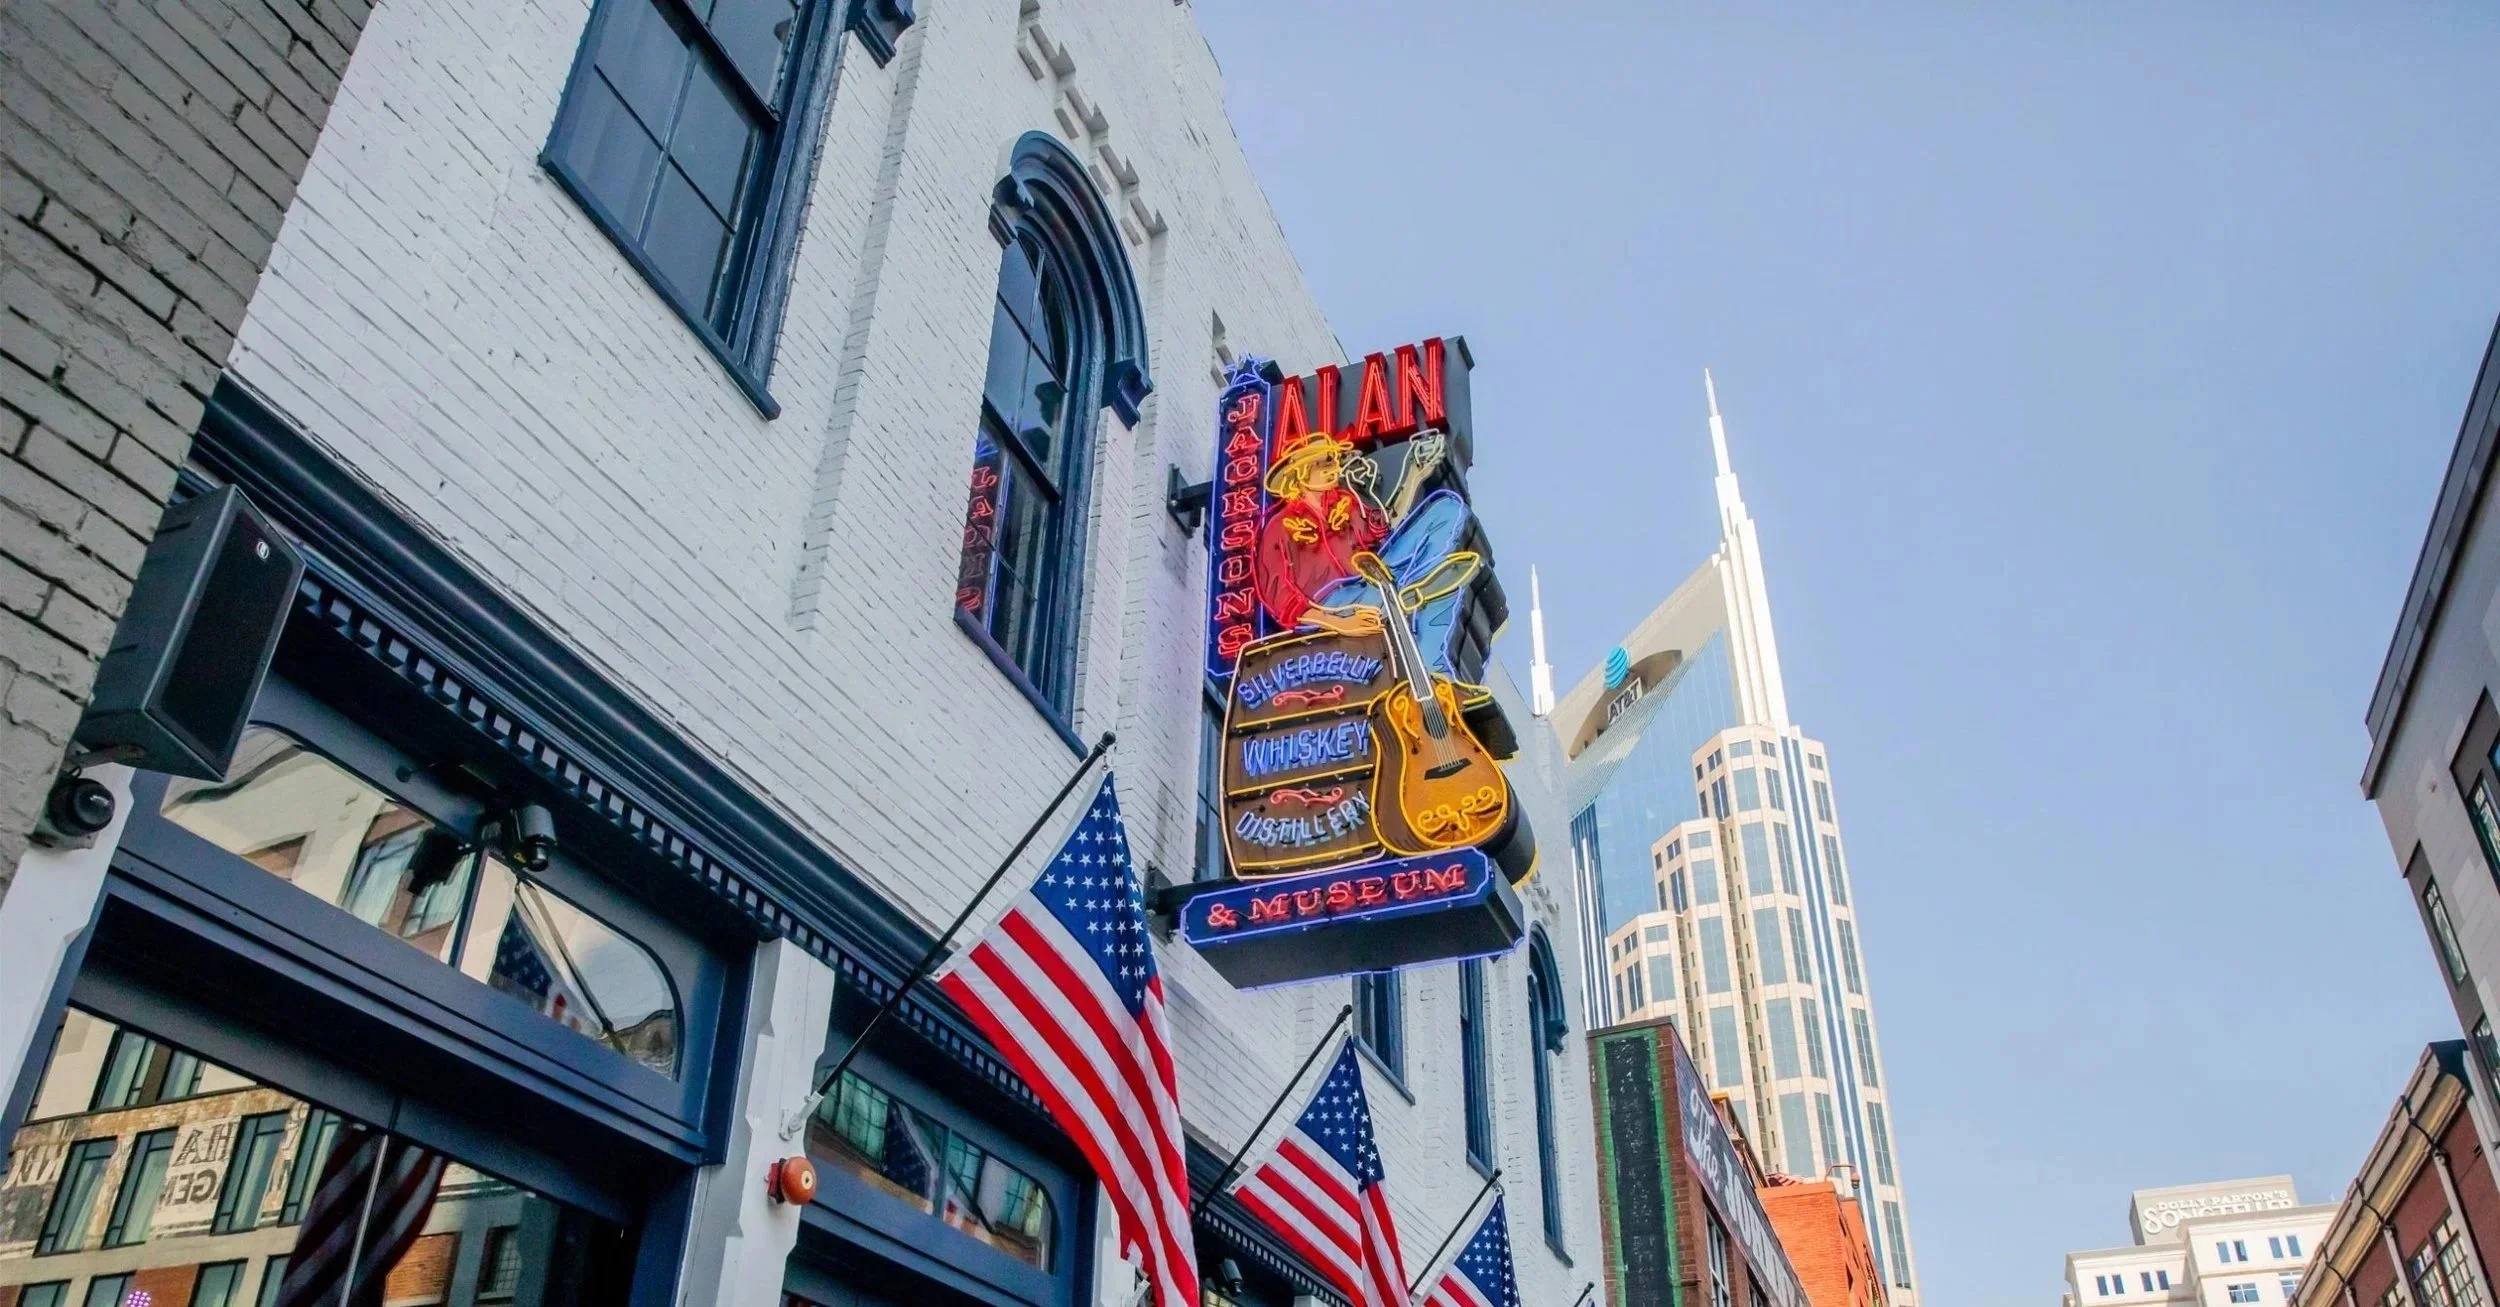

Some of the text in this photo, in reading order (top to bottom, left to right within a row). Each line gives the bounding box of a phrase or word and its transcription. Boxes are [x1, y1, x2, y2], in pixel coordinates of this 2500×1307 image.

[1271, 337, 1448, 464] ALAN
[1237, 651, 1383, 708] SILVERBELLY
[1607, 677, 1643, 724] AT&T
[1243, 719, 1373, 777] WHISKEY
[1235, 788, 1371, 847] DISTILLERY
[1207, 864, 1468, 928] & MUSEUM
[2157, 1190, 2288, 1212] DOLLY PARTON'S
